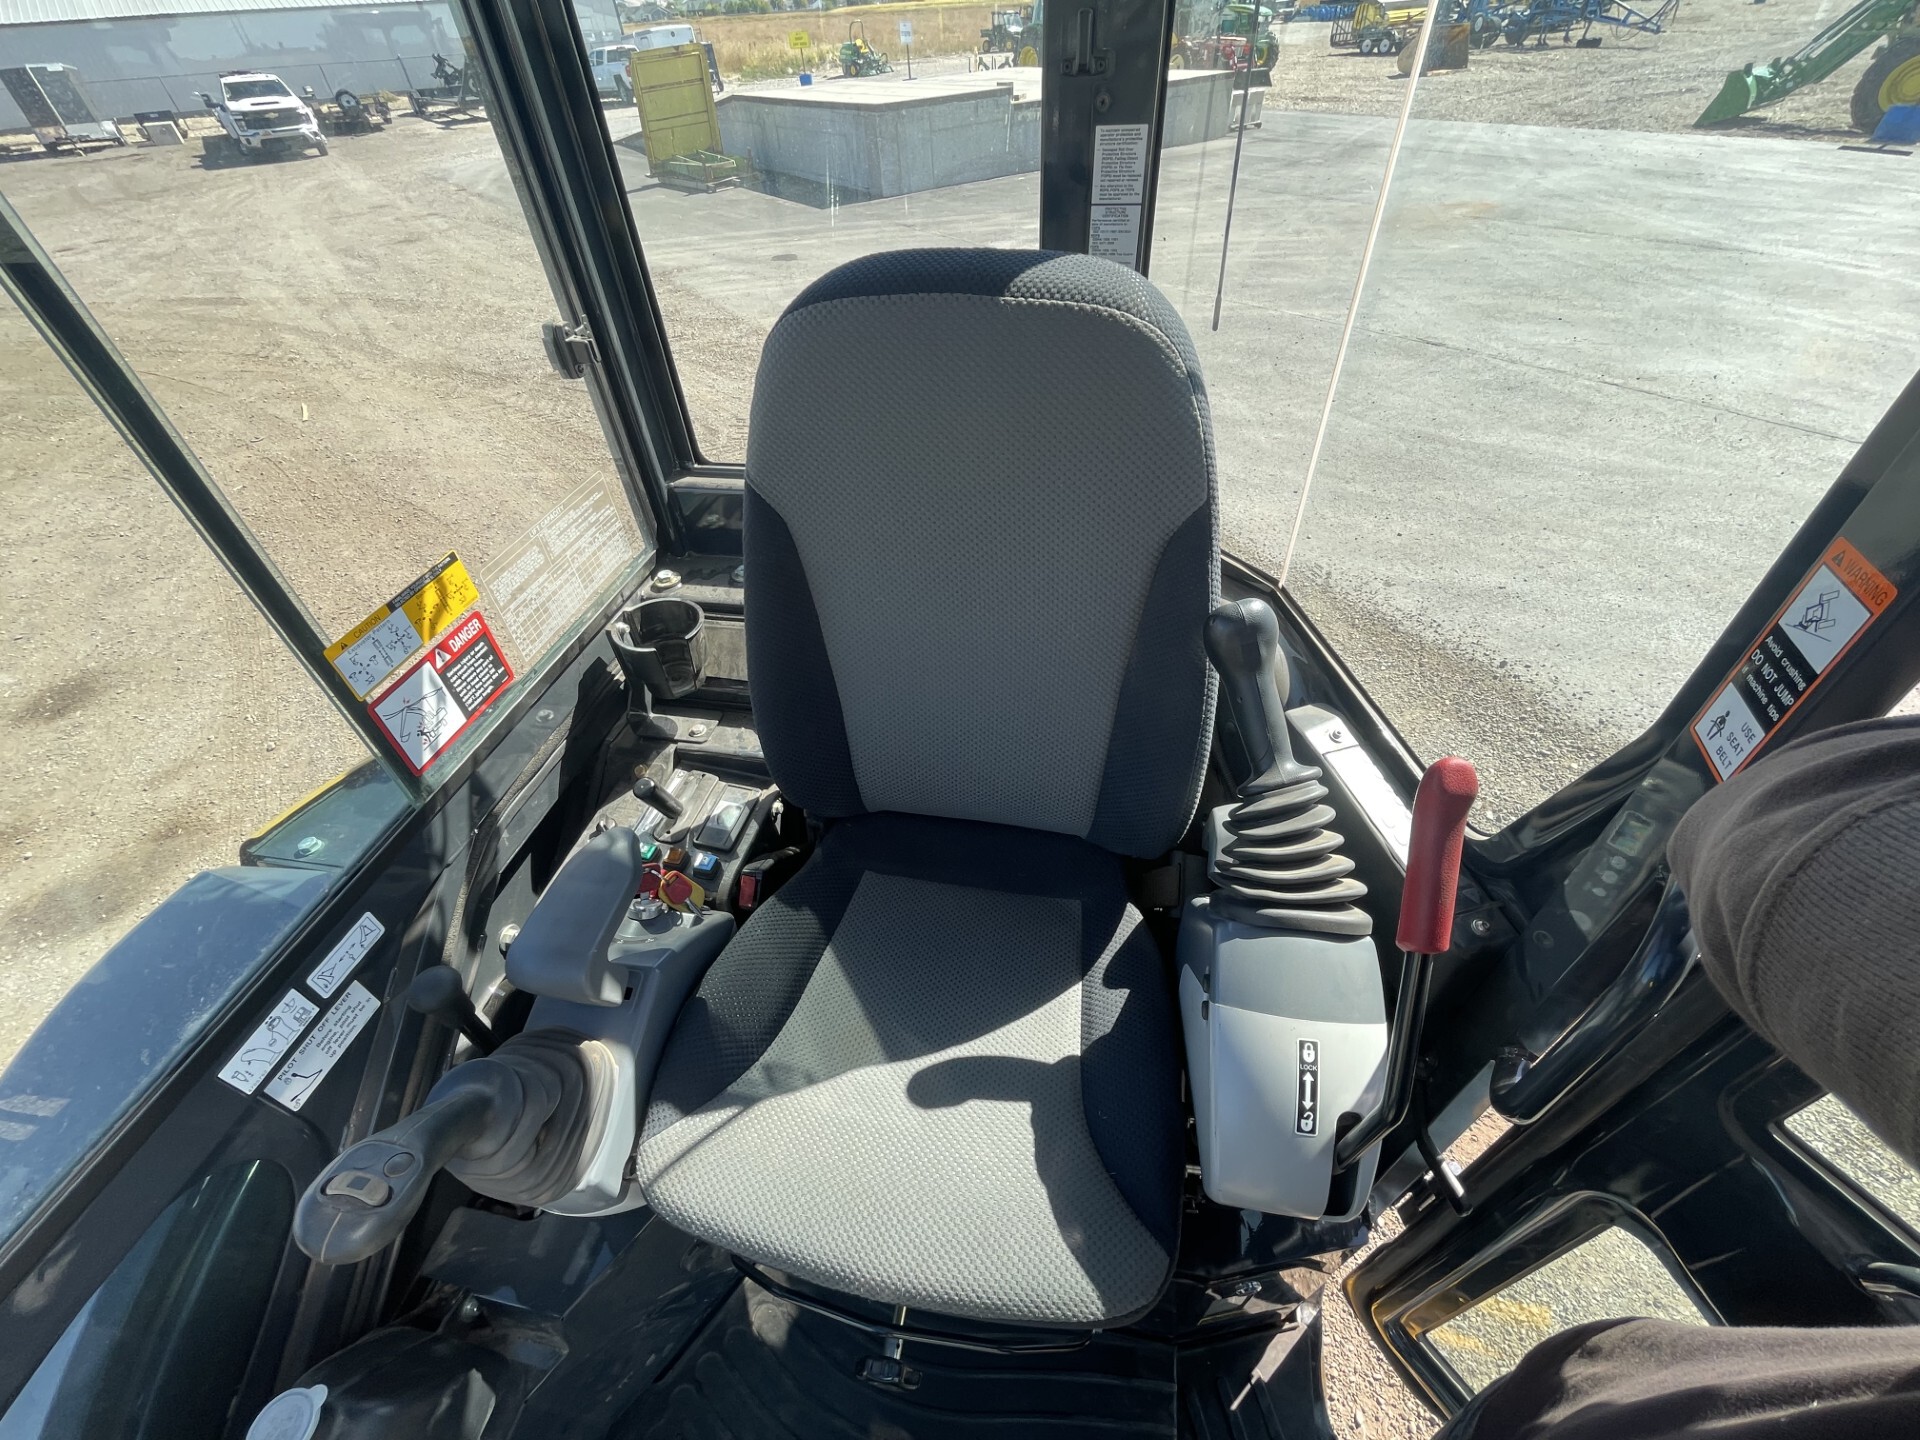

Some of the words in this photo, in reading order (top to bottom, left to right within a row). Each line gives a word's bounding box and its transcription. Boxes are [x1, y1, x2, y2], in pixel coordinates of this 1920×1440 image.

[528, 525, 540, 538] LIFT
[540, 504, 564, 528] CAPACITY
[1843, 558, 1888, 606] WARNING
[353, 614, 381, 638] CAUTION
[448, 618, 482, 652] DANGER
[1751, 649, 1764, 665] DO
[1761, 663, 1777, 684] NOT
[1774, 684, 1795, 707] JUMP
[1765, 635, 1782, 657] Avoid
[1781, 657, 1807, 691] crushing
[1746, 674, 1768, 705] machine
[1766, 704, 1780, 722] tips
[1726, 732, 1744, 756] SEAT
[1741, 722, 1756, 744] USE
[1716, 746, 1732, 769] BELT
[332, 1004, 351, 1026] starting
[332, 1029, 345, 1044] lever
[345, 1013, 358, 1027] must
[358, 1003, 366, 1011] be
[276, 1057, 298, 1080] PILOT
[298, 1034, 316, 1055] SHUT
[316, 1017, 330, 1032] OFF
[331, 991, 351, 1015] LEVER
[328, 1049, 337, 1058] up
